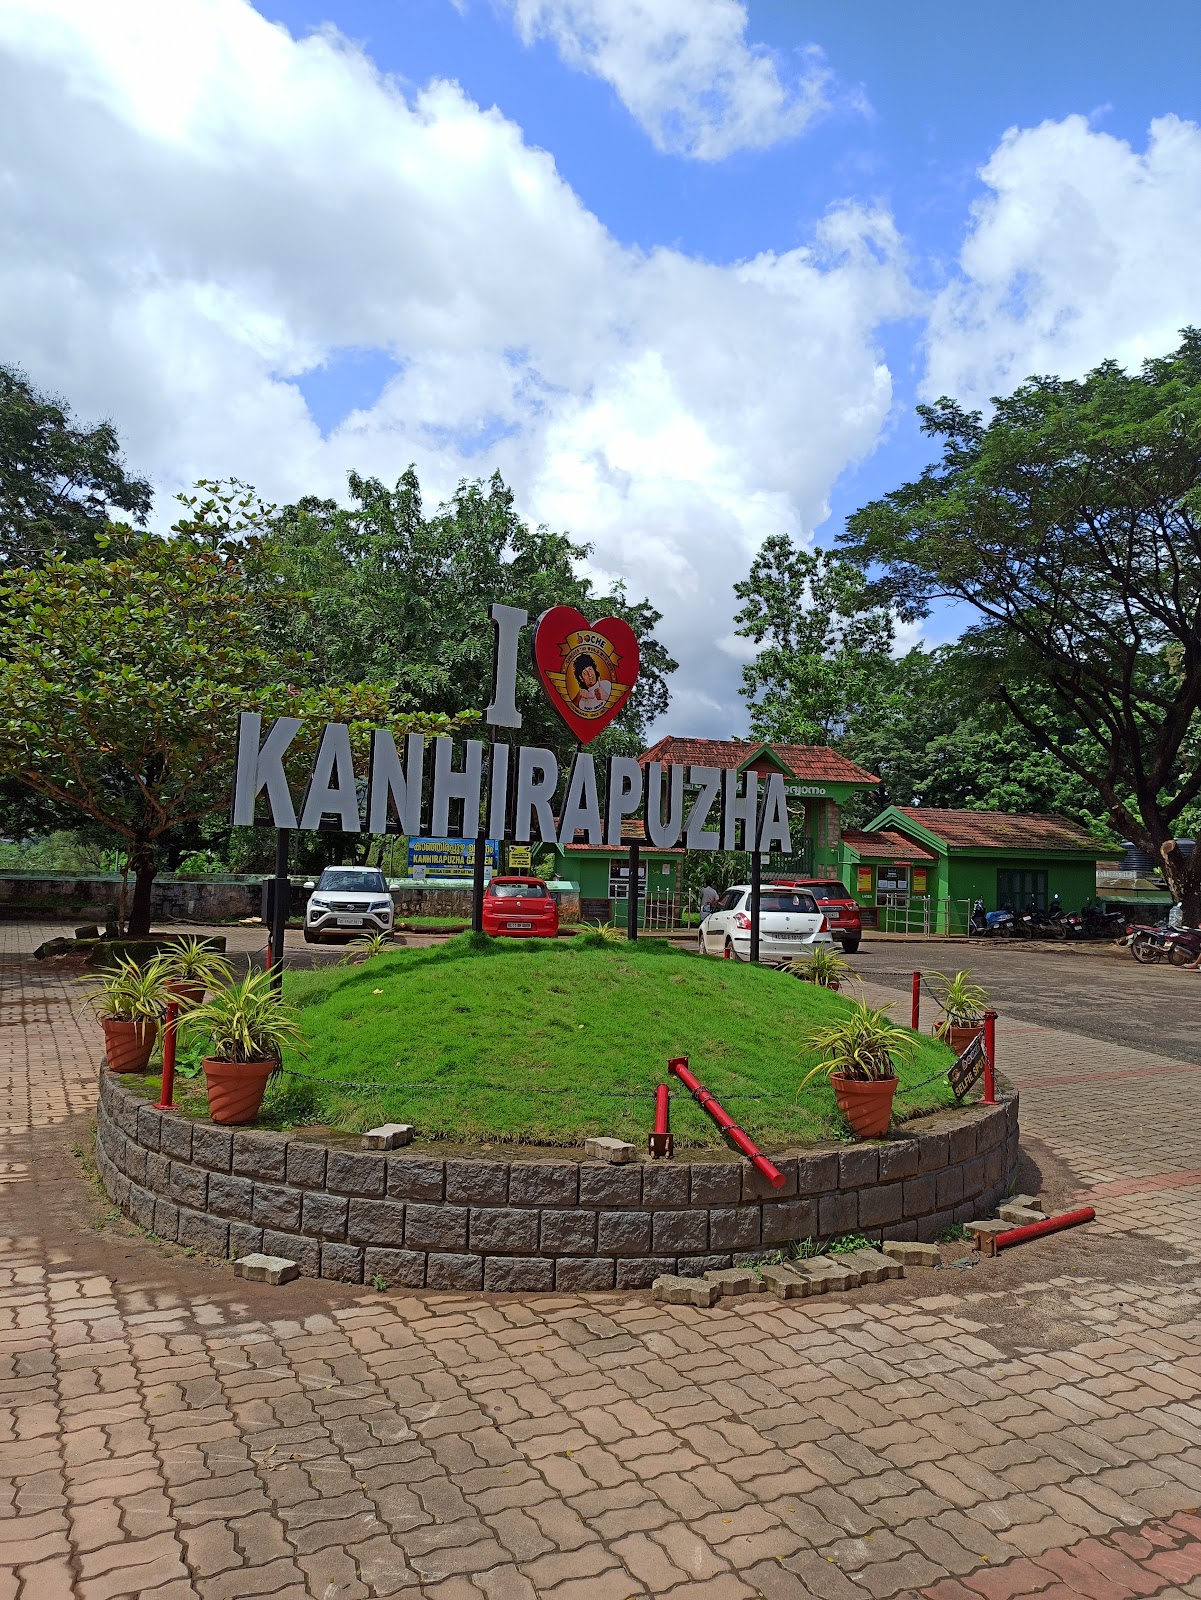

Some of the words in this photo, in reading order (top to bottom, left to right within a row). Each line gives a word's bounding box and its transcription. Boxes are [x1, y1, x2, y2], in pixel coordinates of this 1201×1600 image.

[487, 603, 528, 728] I
[231, 712, 792, 853] KANHIRAPUZHA
[413, 855, 465, 865] KANHIRAPUZHA
[466, 856, 493, 865] GAEN
[955, 1071, 974, 1097] SELFIE
